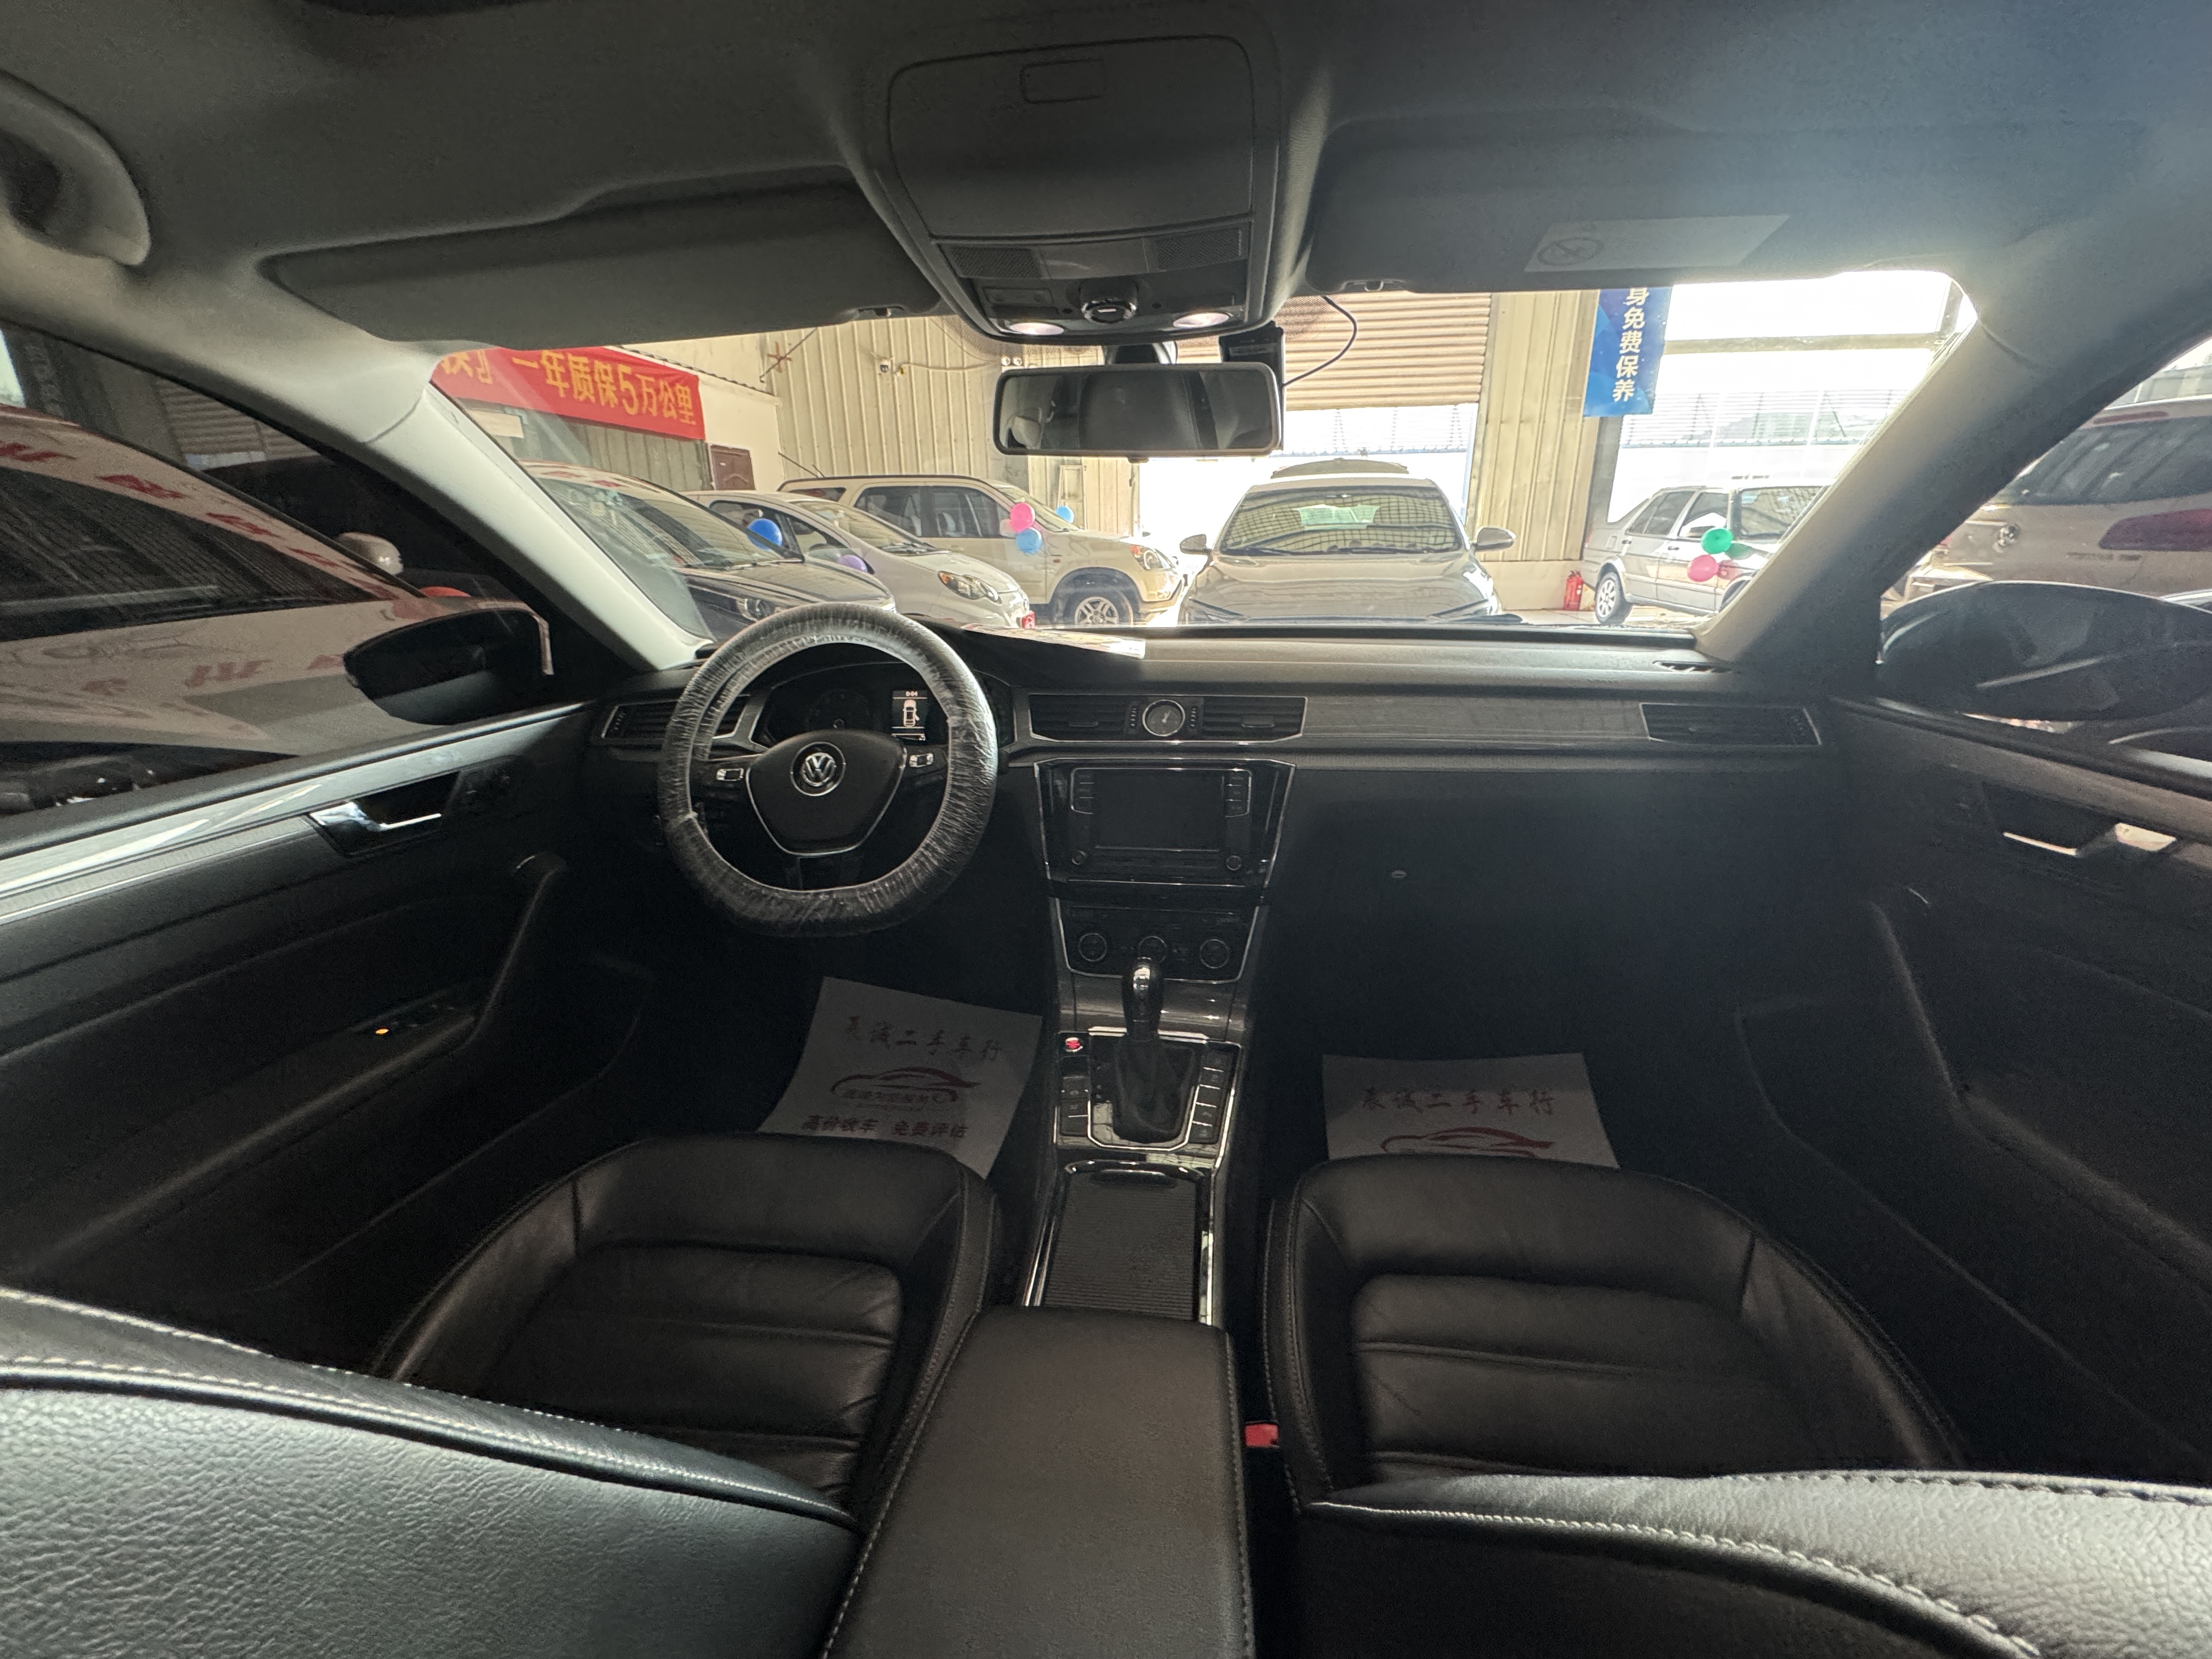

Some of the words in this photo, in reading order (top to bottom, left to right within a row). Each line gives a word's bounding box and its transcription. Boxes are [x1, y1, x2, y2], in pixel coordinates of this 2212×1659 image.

[512, 349, 696, 425] 一年质保5万公里
[1612, 288, 1650, 402] 身免费保养
